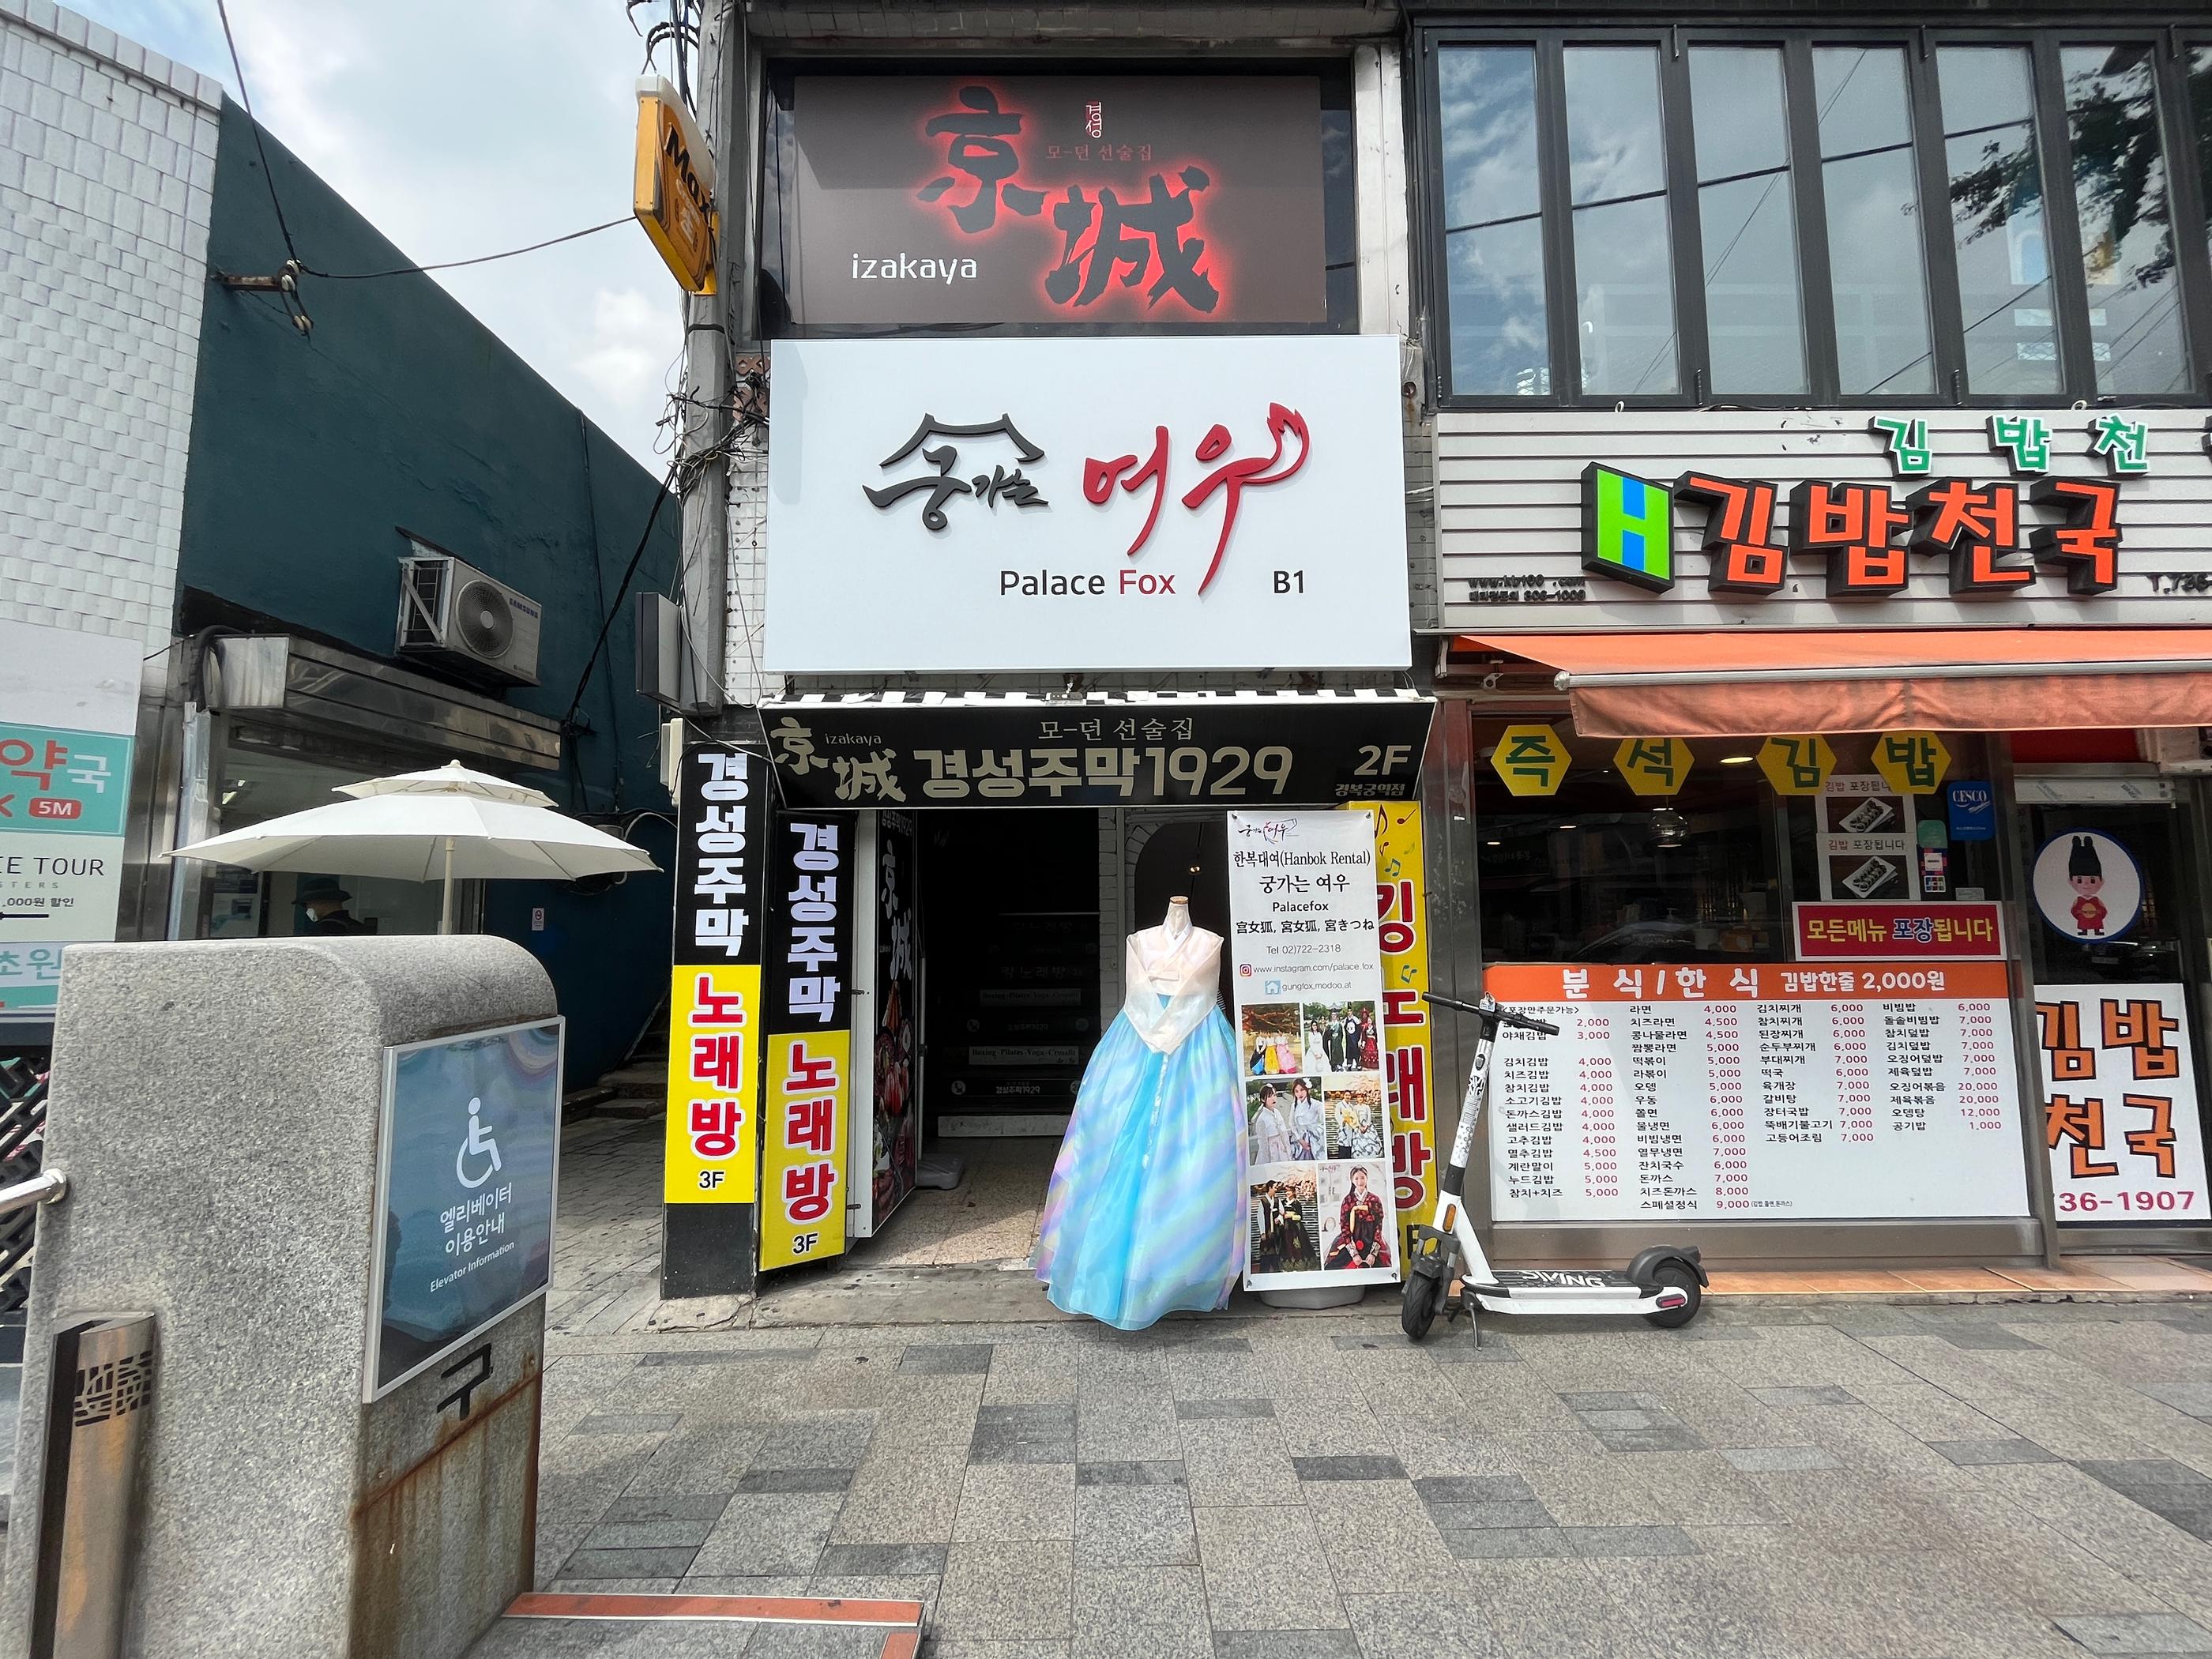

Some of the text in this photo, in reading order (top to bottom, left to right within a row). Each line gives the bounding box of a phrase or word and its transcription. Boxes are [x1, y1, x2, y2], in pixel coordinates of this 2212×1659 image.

[1097, 142, 1153, 162] 선술집
[852, 252, 978, 286] izakaya
[1681, 472, 2122, 595] 김밥천국
[1000, 569, 1305, 597] Palace Fox B1
[1038, 717, 1194, 741] 모-던 선술집
[825, 732, 882, 746] izakaya
[1354, 744, 1412, 777] 2F
[913, 745, 1293, 799] 경성주막1929
[1952, 789, 1988, 803] CESCO
[39, 800, 73, 817] 5M
[1828, 839, 1905, 851] 김밥 포장됩니다
[694, 752, 749, 957] 경성주막
[1233, 848, 1371, 868] 한복대여(Hanbok Rental)
[33, 857, 104, 876] TOUR
[1259, 874, 1351, 894] 궁가는 여우
[1272, 901, 1330, 913] Palacefox
[787, 822, 841, 1023] 경성주막
[1807, 917, 1993, 943] 모든메뉴 포장됩니다
[1266, 944, 1342, 955] Tel 02)722-2318
[1780, 969, 1946, 994] 김밥한줄 2,000원
[1630, 1005, 1737, 1015] 라면 4,000
[1757, 1004, 1864, 1014] 김치찌개 6,000
[1883, 1003, 1990, 1014] 비빔밥 6,000
[1577, 1018, 1610, 1029] 2,000
[1631, 1018, 1738, 1028] 치즈라면 4,500
[1758, 1017, 1864, 1027] 참치찌개 6,000
[1959, 1016, 1991, 1026] 7,000
[1578, 1032, 1610, 1040] 3,000
[1706, 1030, 1739, 1040] 4,500
[1759, 1029, 1865, 1040] 된장찌개 6,000
[1884, 1029, 1992, 1039] 참치덮밥 7,000
[1834, 1040, 1866, 1051] 6,000
[2035, 998, 2180, 1082] 김밥
[1707, 1043, 1739, 1053] 5,000
[1887, 1041, 1993, 1051] 김치덮밥 7,000
[1503, 1058, 1611, 1067] 김치김밥 4,000
[1707, 1055, 1740, 1066] 5,000
[1760, 1055, 1867, 1065] 부대찌개 7,000
[1887, 1054, 1995, 1064] 오징어덮밥 7,000
[689, 975, 744, 1159] 노래방
[1888, 1066, 1996, 1078] 제육덮밥 7,000
[1504, 1070, 1612, 1080] 치즈김밥 4,000
[1709, 1069, 1740, 1079] 5,000
[1762, 1068, 1869, 1078] 떡국 6,000
[1505, 1083, 1612, 1093] 참치김밥 4,000
[1710, 1082, 1741, 1093] 5,000
[1837, 1080, 1869, 1090] 7,000
[1958, 1082, 1997, 1093] 20,000
[1505, 1097, 1613, 1108] 소고기김밥 4,000
[1635, 1095, 1742, 1107] 우동 6,000
[1763, 1094, 1871, 1104] 갈비탕 7,000
[1959, 1095, 1999, 1105] 20,000
[1506, 1109, 1614, 1119] 돈까스김밥 4,000
[1711, 1108, 1744, 1119] 6,000
[1764, 1108, 1872, 1118] 장터국밥 7,000
[1961, 1108, 2000, 1118] 12,000
[1507, 1123, 1615, 1132] 샐러드김밥 4,000
[1712, 1122, 1744, 1132] 6,000
[1840, 1120, 1872, 1130] 7,000
[1892, 1121, 2001, 1131] 공기밥 1,000
[784, 1042, 837, 1223] 노래방
[1766, 1133, 1874, 1143] 고등어조림 7,000
[2044, 1093, 2177, 1179] 천국
[1507, 1135, 1616, 1145] 고추김밥 4,000
[1638, 1134, 1745, 1145] 비빔냉면 6,000
[1583, 1149, 1616, 1158] 4,500
[1713, 1147, 1746, 1157] 7,000
[1508, 1161, 1617, 1172] 계란말이 5,000
[1638, 1161, 1747, 1172] 잔치국수 6,000
[698, 1170, 726, 1190] 3F
[1508, 1175, 1617, 1185] 누드김밥 5,000
[1638, 1174, 1747, 1183] 돈까스 7,000
[1509, 1188, 1618, 1198] 참치+치즈 5,000
[1640, 1187, 1748, 1197] 치즈돈까스 8,000
[440, 1182, 513, 1234] 엘리베이터
[1640, 1200, 1697, 1210] 스페셜정식
[1717, 1200, 1750, 1210] 9,000
[445, 1212, 506, 1257] 이용안내
[792, 1232, 818, 1255] 3F
[429, 1241, 515, 1293] Elevator Information
